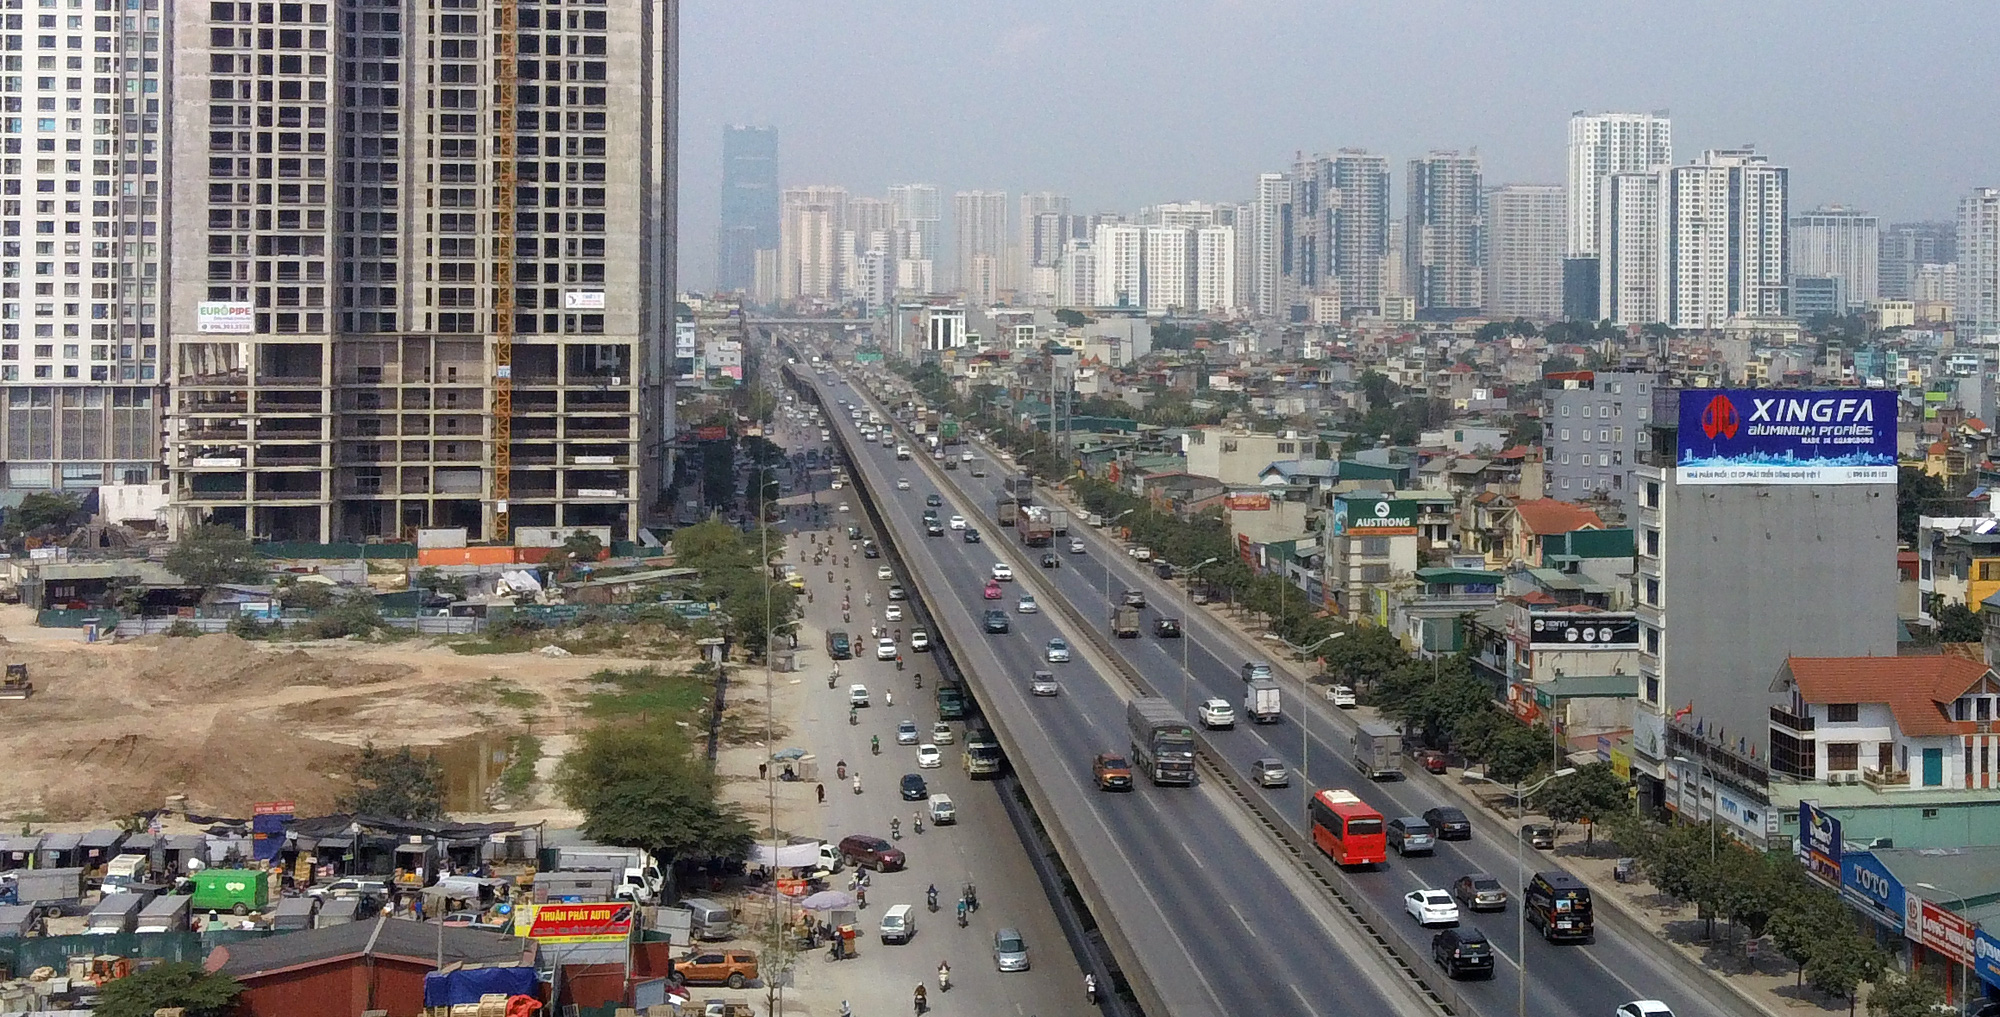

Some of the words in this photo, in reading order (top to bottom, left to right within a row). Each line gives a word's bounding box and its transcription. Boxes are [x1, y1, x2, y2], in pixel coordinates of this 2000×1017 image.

[1748, 398, 1874, 422] XINGFA
[1355, 517, 1410, 527] AUSTRONG
[1853, 863, 1889, 899] TOTO
[540, 909, 567, 923] THUẬN
[568, 908, 588, 920] PHÁT
[590, 910, 611, 920] AUTO
